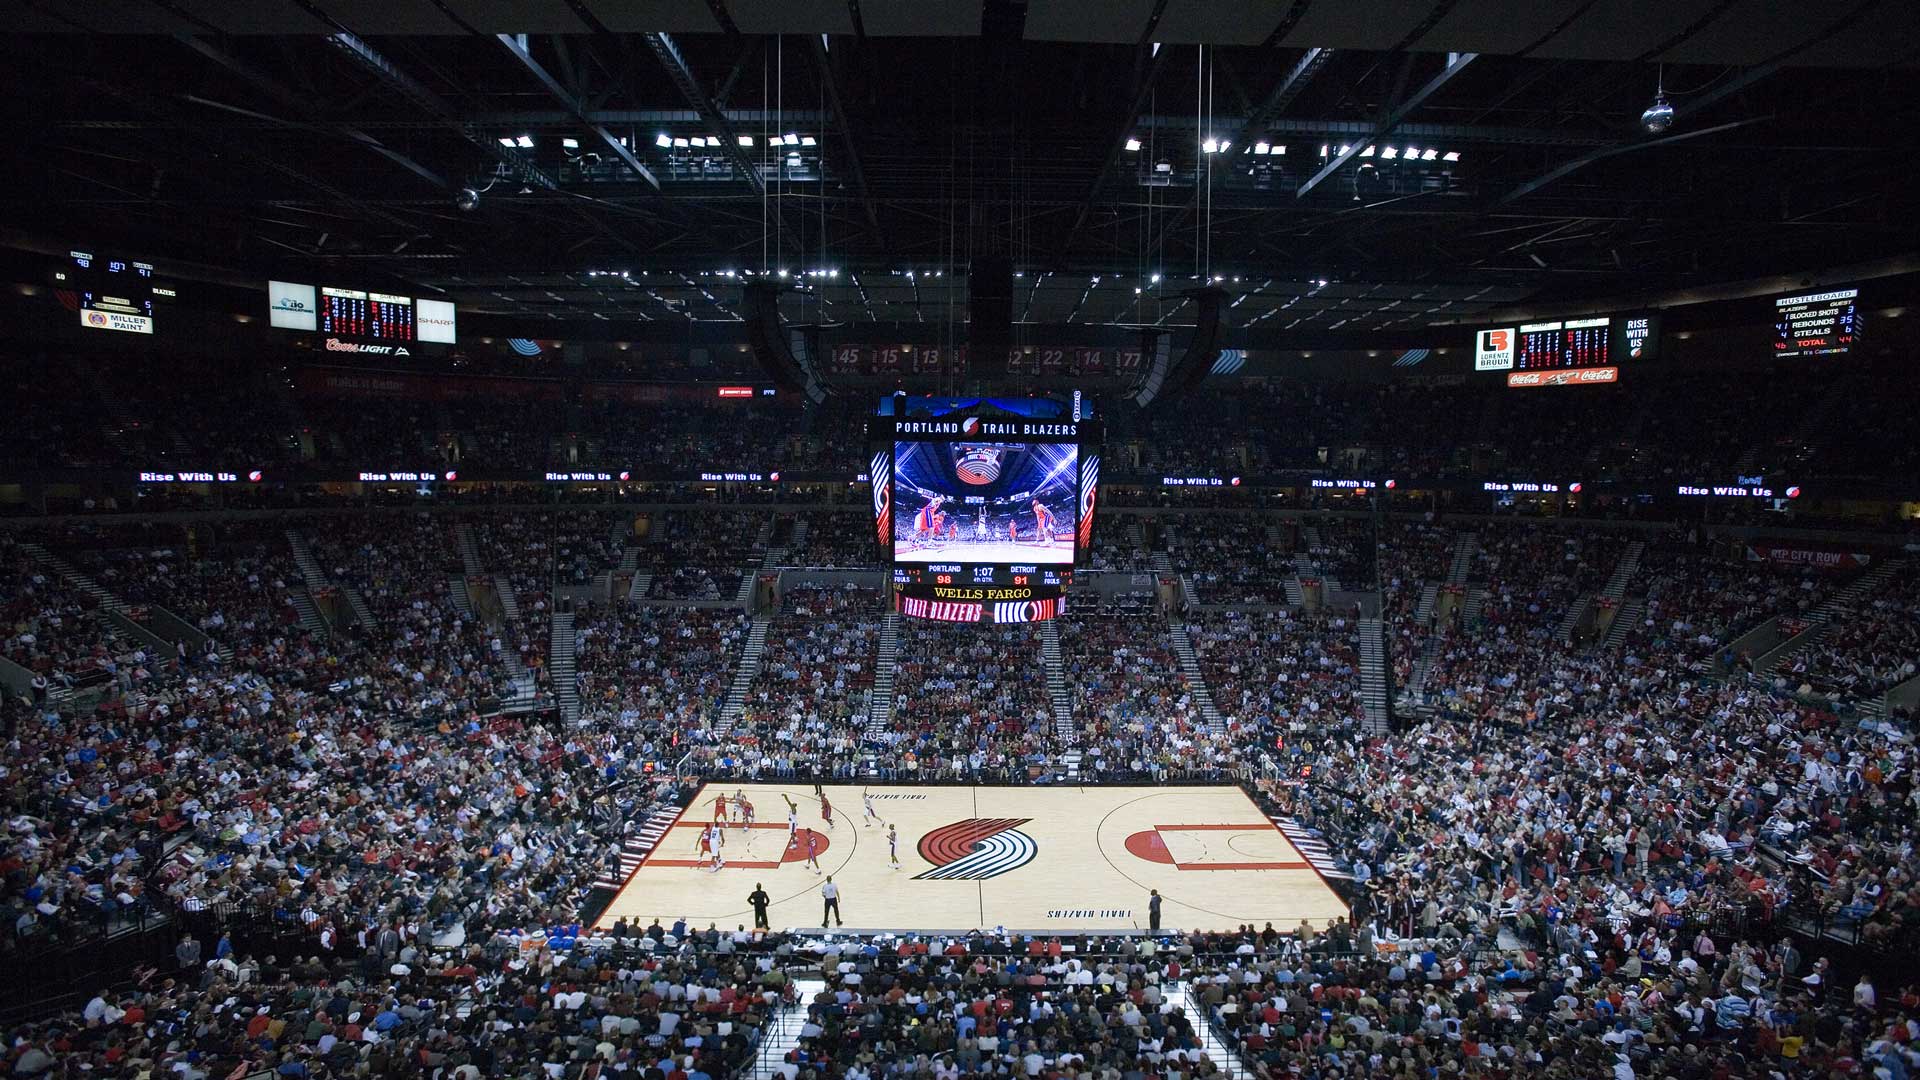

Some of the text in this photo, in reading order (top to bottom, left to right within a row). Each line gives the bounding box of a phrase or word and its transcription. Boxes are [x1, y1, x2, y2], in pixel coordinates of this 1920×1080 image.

[77, 259, 89, 268] 98
[139, 269, 151, 277] 91
[152, 288, 176, 297] BLAZERS
[1781, 291, 1851, 305] HUSTLEBOARD
[1779, 305, 1808, 313] BLAZERS
[1790, 308, 1839, 320] BLOCKED SHOTS
[1847, 305, 1854, 314] 3
[110, 315, 146, 325] MILLER
[418, 317, 454, 326] SHARP
[1627, 319, 1648, 329] RISE
[1792, 318, 1835, 328] REBOUNDS
[1840, 316, 1852, 324] 35
[114, 322, 143, 331] PAINT
[1626, 328, 1648, 338] WITH
[1794, 328, 1831, 337] STEALS
[326, 338, 392, 354] Coors LIGHT
[1630, 338, 1643, 347] US
[1797, 339, 1827, 347] TOTAL
[839, 350, 859, 364] 45
[881, 350, 898, 364] 15
[922, 350, 939, 364] 13
[1043, 351, 1063, 365] 22
[1084, 351, 1101, 365] 14
[1124, 352, 1141, 367] 77
[1480, 358, 1509, 366] BRUUN
[896, 422, 1077, 435] PORTLAND TRAIL BLAZERS
[140, 472, 237, 481] Rise With Us
[1163, 477, 1185, 485] Rise
[1187, 477, 1208, 485] With
[1337, 480, 1359, 488] With
[1512, 483, 1538, 491] With
[1542, 484, 1558, 492] Us
[1678, 486, 1772, 497] Rise With Us
[1771, 548, 1840, 563] RIP CITY ROW
[973, 567, 994, 577] 1:07
[937, 575, 952, 584] 98
[1014, 576, 1028, 585] 91
[934, 587, 1031, 600] WELLS FARGO
[904, 597, 983, 622] TRAIL BLAZERS
